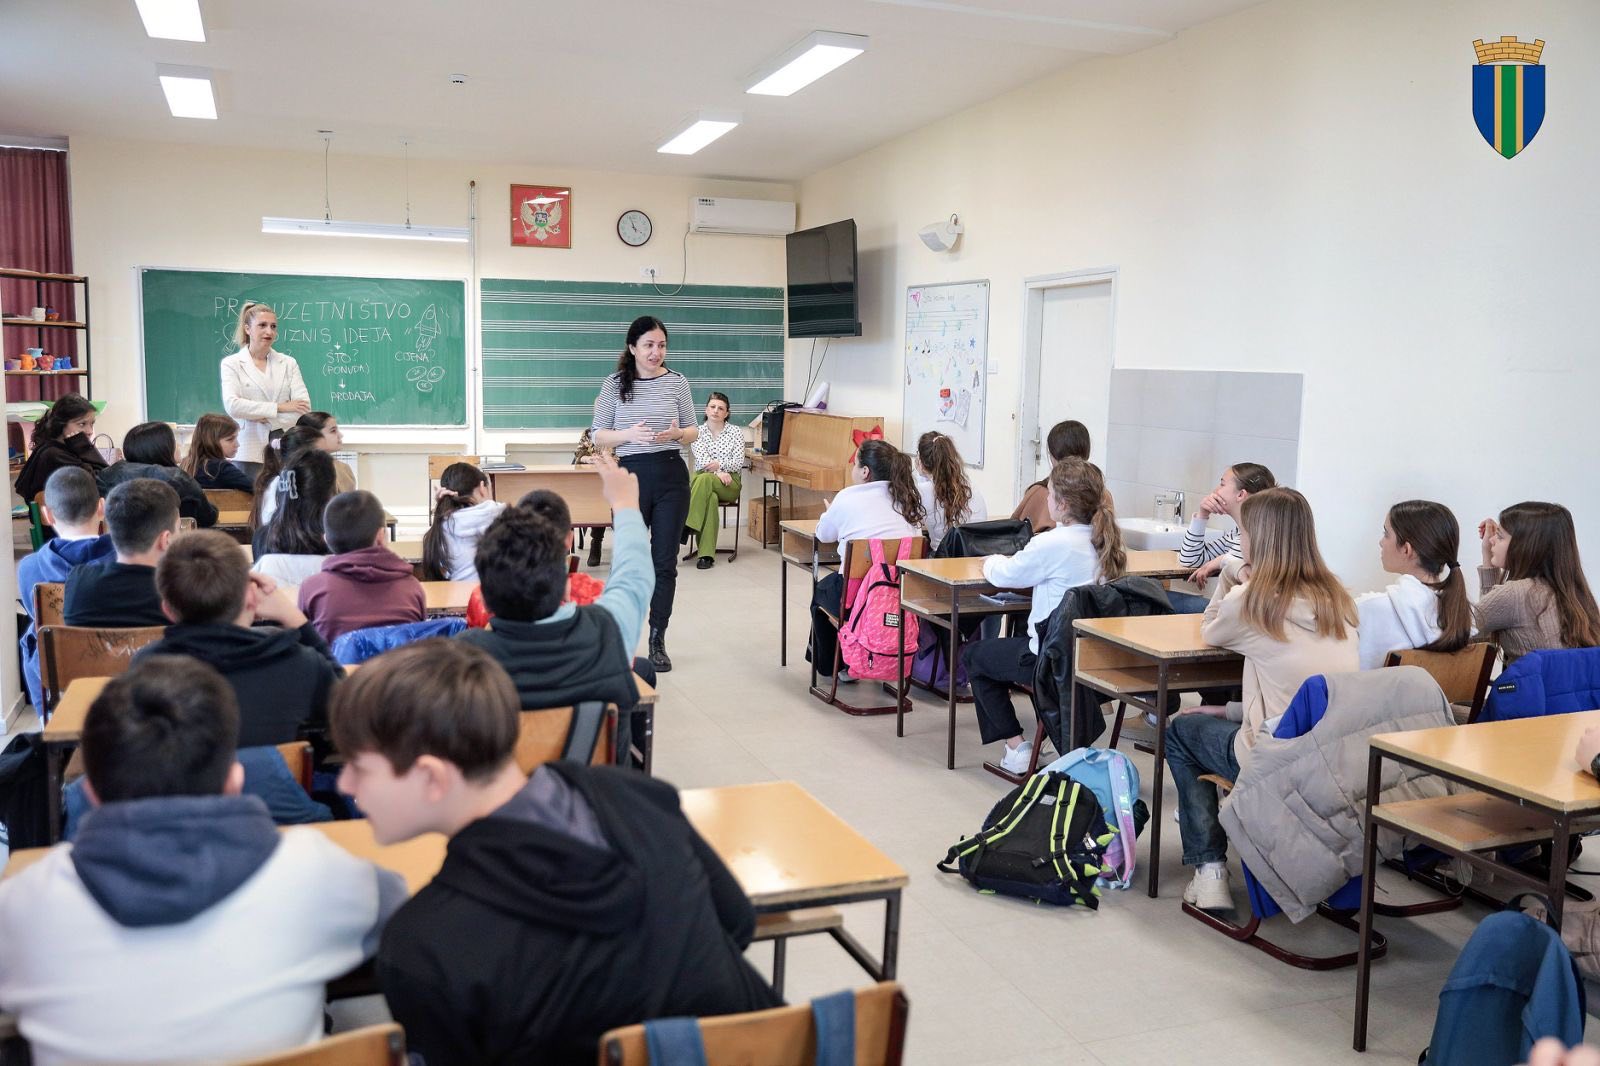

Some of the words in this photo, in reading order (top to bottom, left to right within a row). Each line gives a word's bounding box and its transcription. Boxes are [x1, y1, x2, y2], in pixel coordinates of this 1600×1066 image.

[214, 296, 411, 322] PRUZETNIŠTVO
[274, 327, 331, 343] IZNIS
[343, 328, 393, 344] IDEJA
[322, 362, 370, 377] (PONUDA)
[330, 391, 376, 403] PRODAJA
